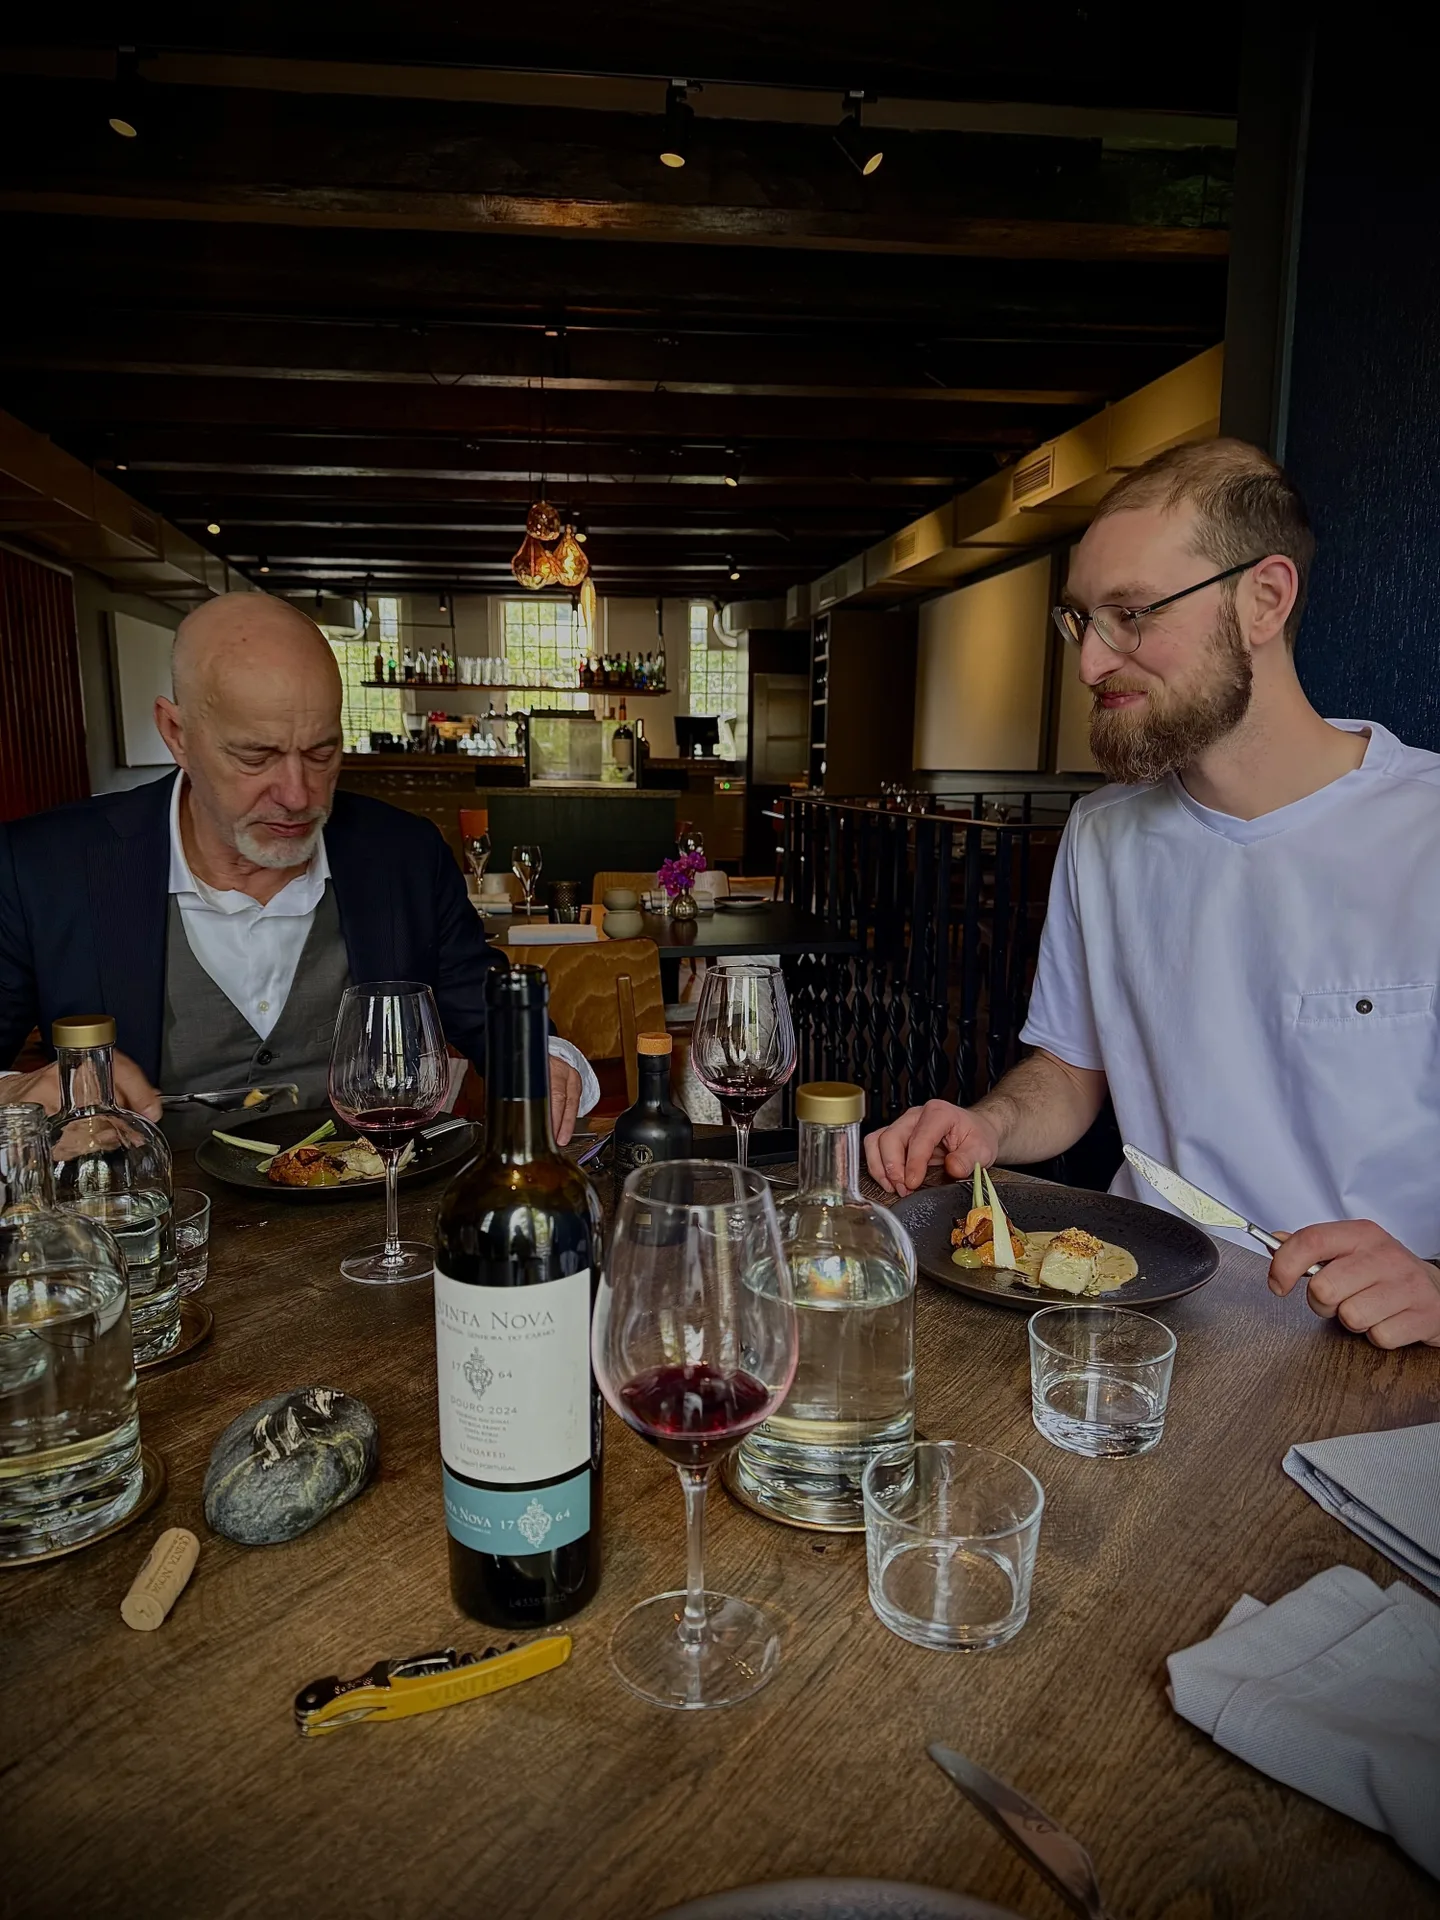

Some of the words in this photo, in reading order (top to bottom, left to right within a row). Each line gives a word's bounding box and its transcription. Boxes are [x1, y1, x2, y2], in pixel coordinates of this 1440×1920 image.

[491, 1310, 554, 1330] NOVA
[498, 1370, 513, 1379] 64
[450, 1395, 484, 1413] DOURO
[488, 1406, 518, 1416] 2024
[460, 1442, 507, 1459] UNOAKED
[459, 1506, 493, 1529] NOVA
[501, 1520, 514, 1531] 17
[556, 1509, 570, 1522] 64
